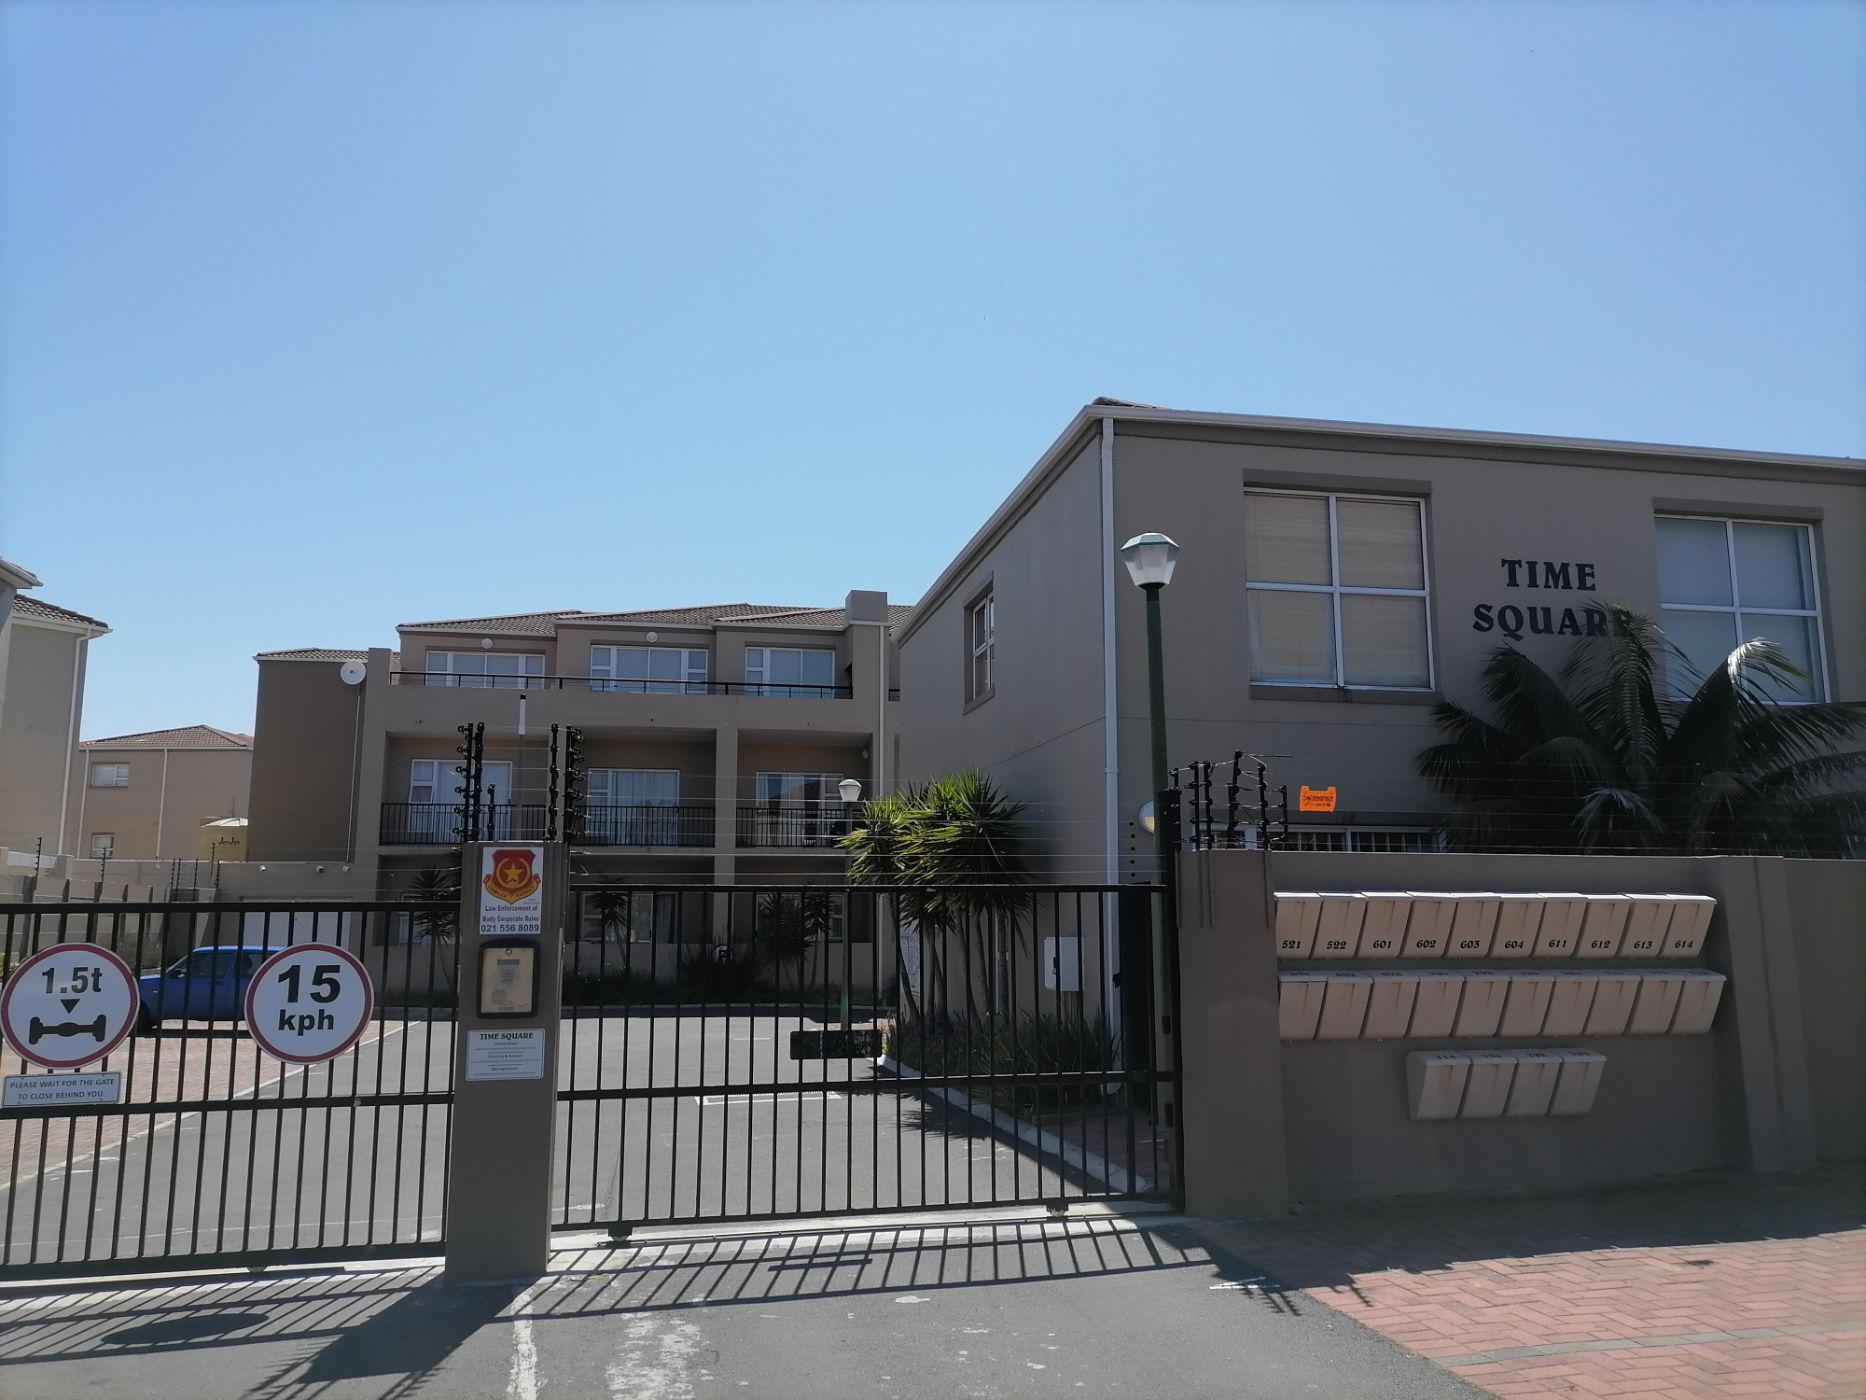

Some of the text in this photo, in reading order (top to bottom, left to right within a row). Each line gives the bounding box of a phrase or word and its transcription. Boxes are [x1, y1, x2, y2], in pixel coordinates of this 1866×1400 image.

[1501, 558, 1596, 591] TIME
[218, 836, 240, 846] JoJo
[482, 915, 496, 923] Body
[481, 924, 540, 932] 021 556 8089
[1281, 939, 1301, 949] 521
[1327, 941, 1347, 950] 522
[1372, 940, 1392, 949] 601
[1416, 939, 1437, 949] 602
[1460, 940, 1480, 949] 603
[1504, 940, 1524, 949] 604
[1548, 939, 1567, 948] 611
[1591, 940, 1611, 949] 612
[1633, 941, 1653, 950] 613
[1674, 940, 1694, 949] 614
[42, 966, 103, 994] 1.5t
[278, 964, 341, 1003] 15
[278, 1009, 334, 1036] kph
[501, 1032, 534, 1040] SQUARE
[10, 1081, 37, 1089] PLEASE
[40, 1080, 60, 1088] WAIT
[96, 1078, 116, 1086] GATE
[56, 1091, 85, 1099] BEHIND
[87, 1090, 104, 1098] YOU
